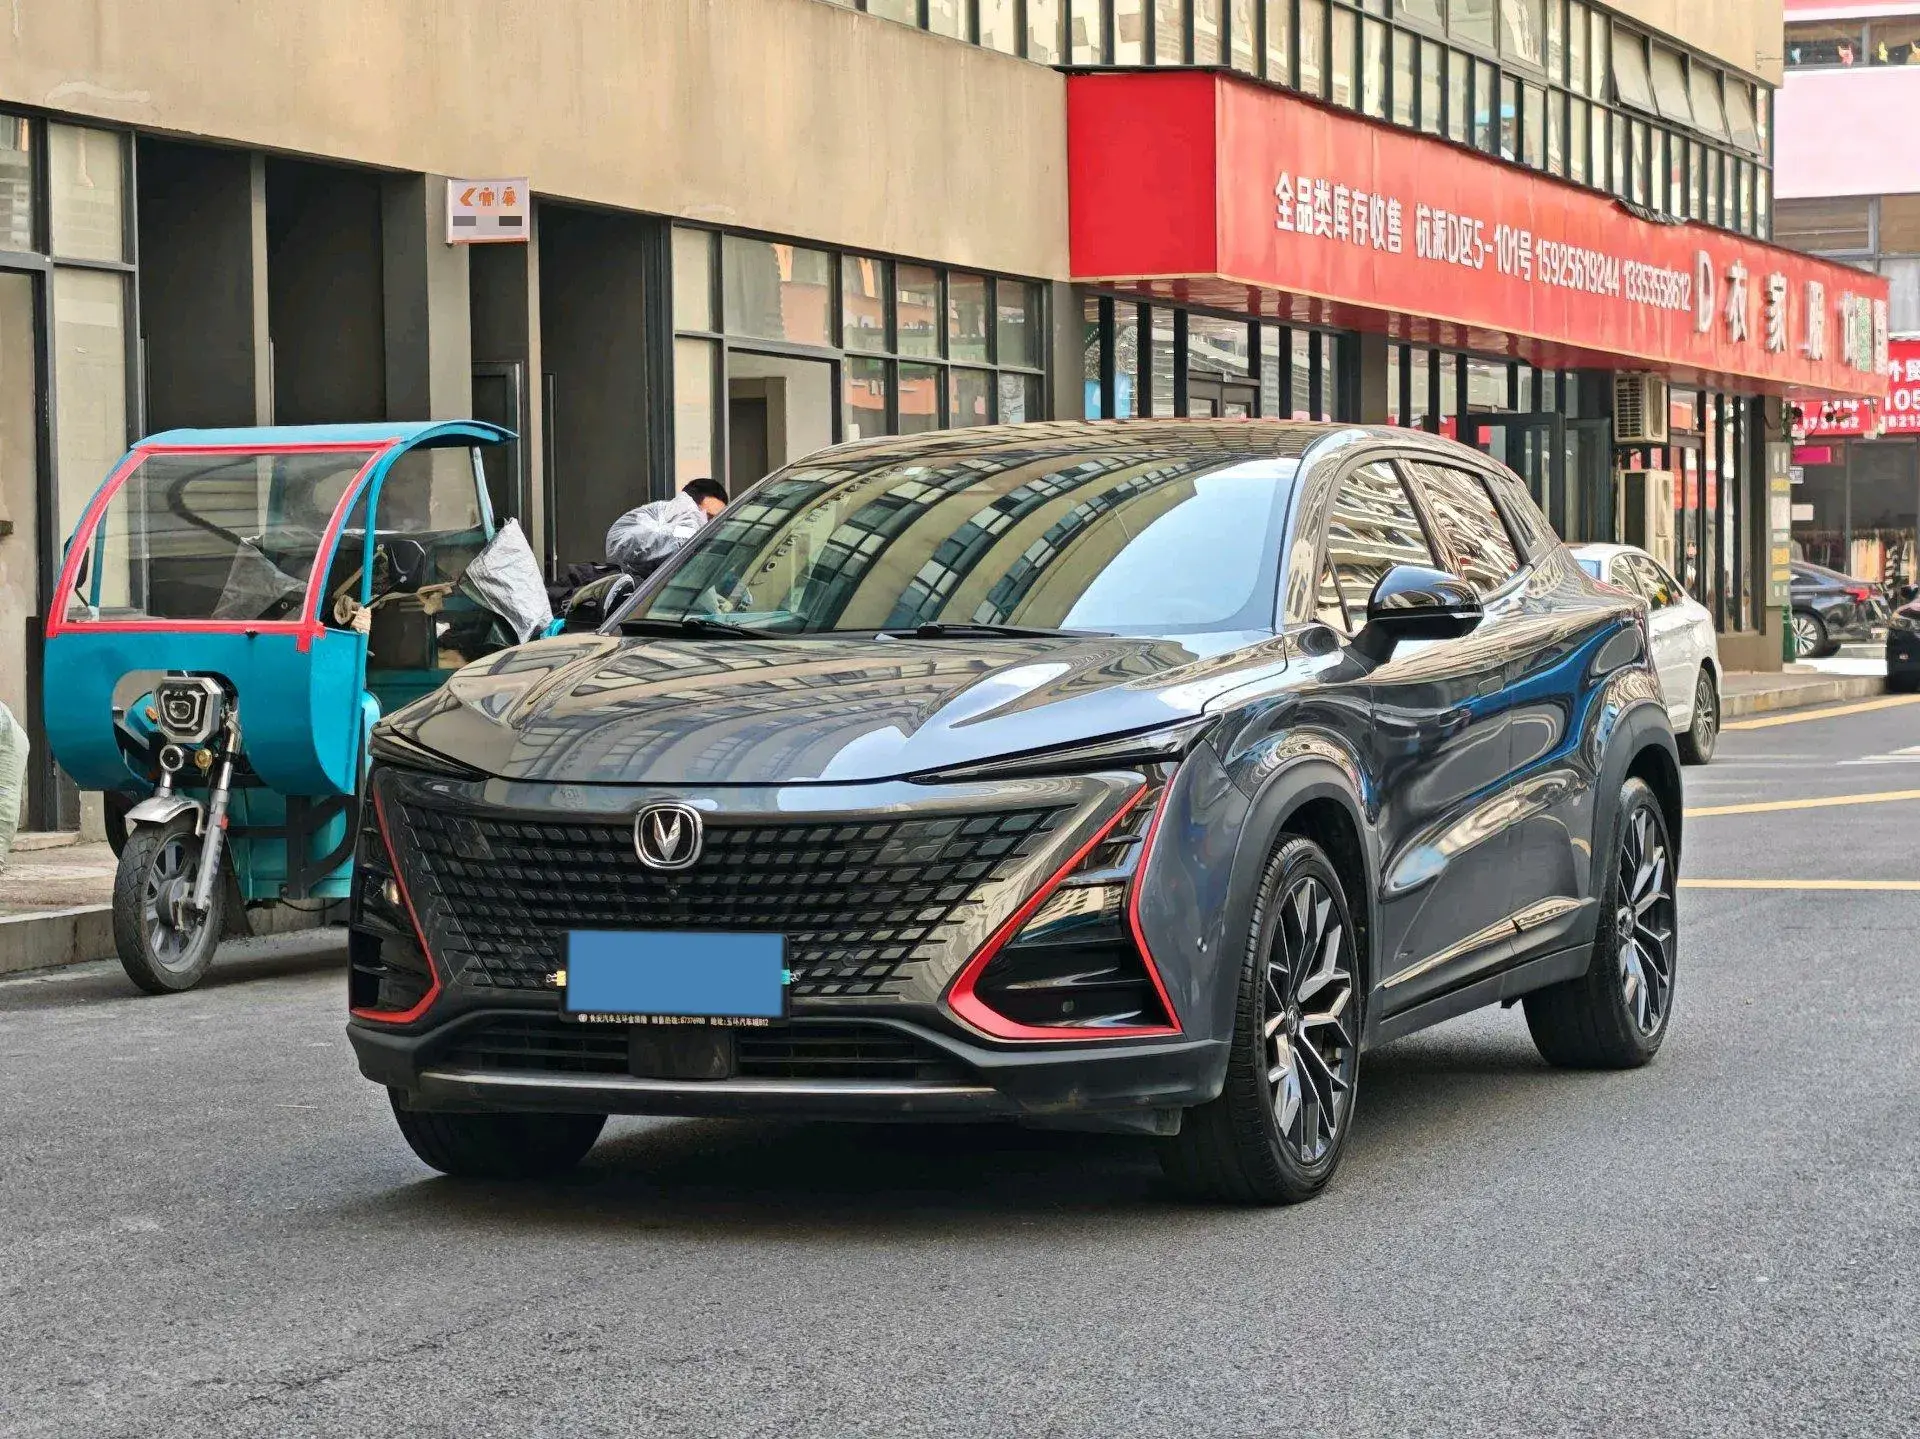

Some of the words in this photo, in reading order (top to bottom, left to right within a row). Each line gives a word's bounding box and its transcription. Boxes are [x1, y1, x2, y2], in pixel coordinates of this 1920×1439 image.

[1274, 170, 1403, 254] 全品类库存收售
